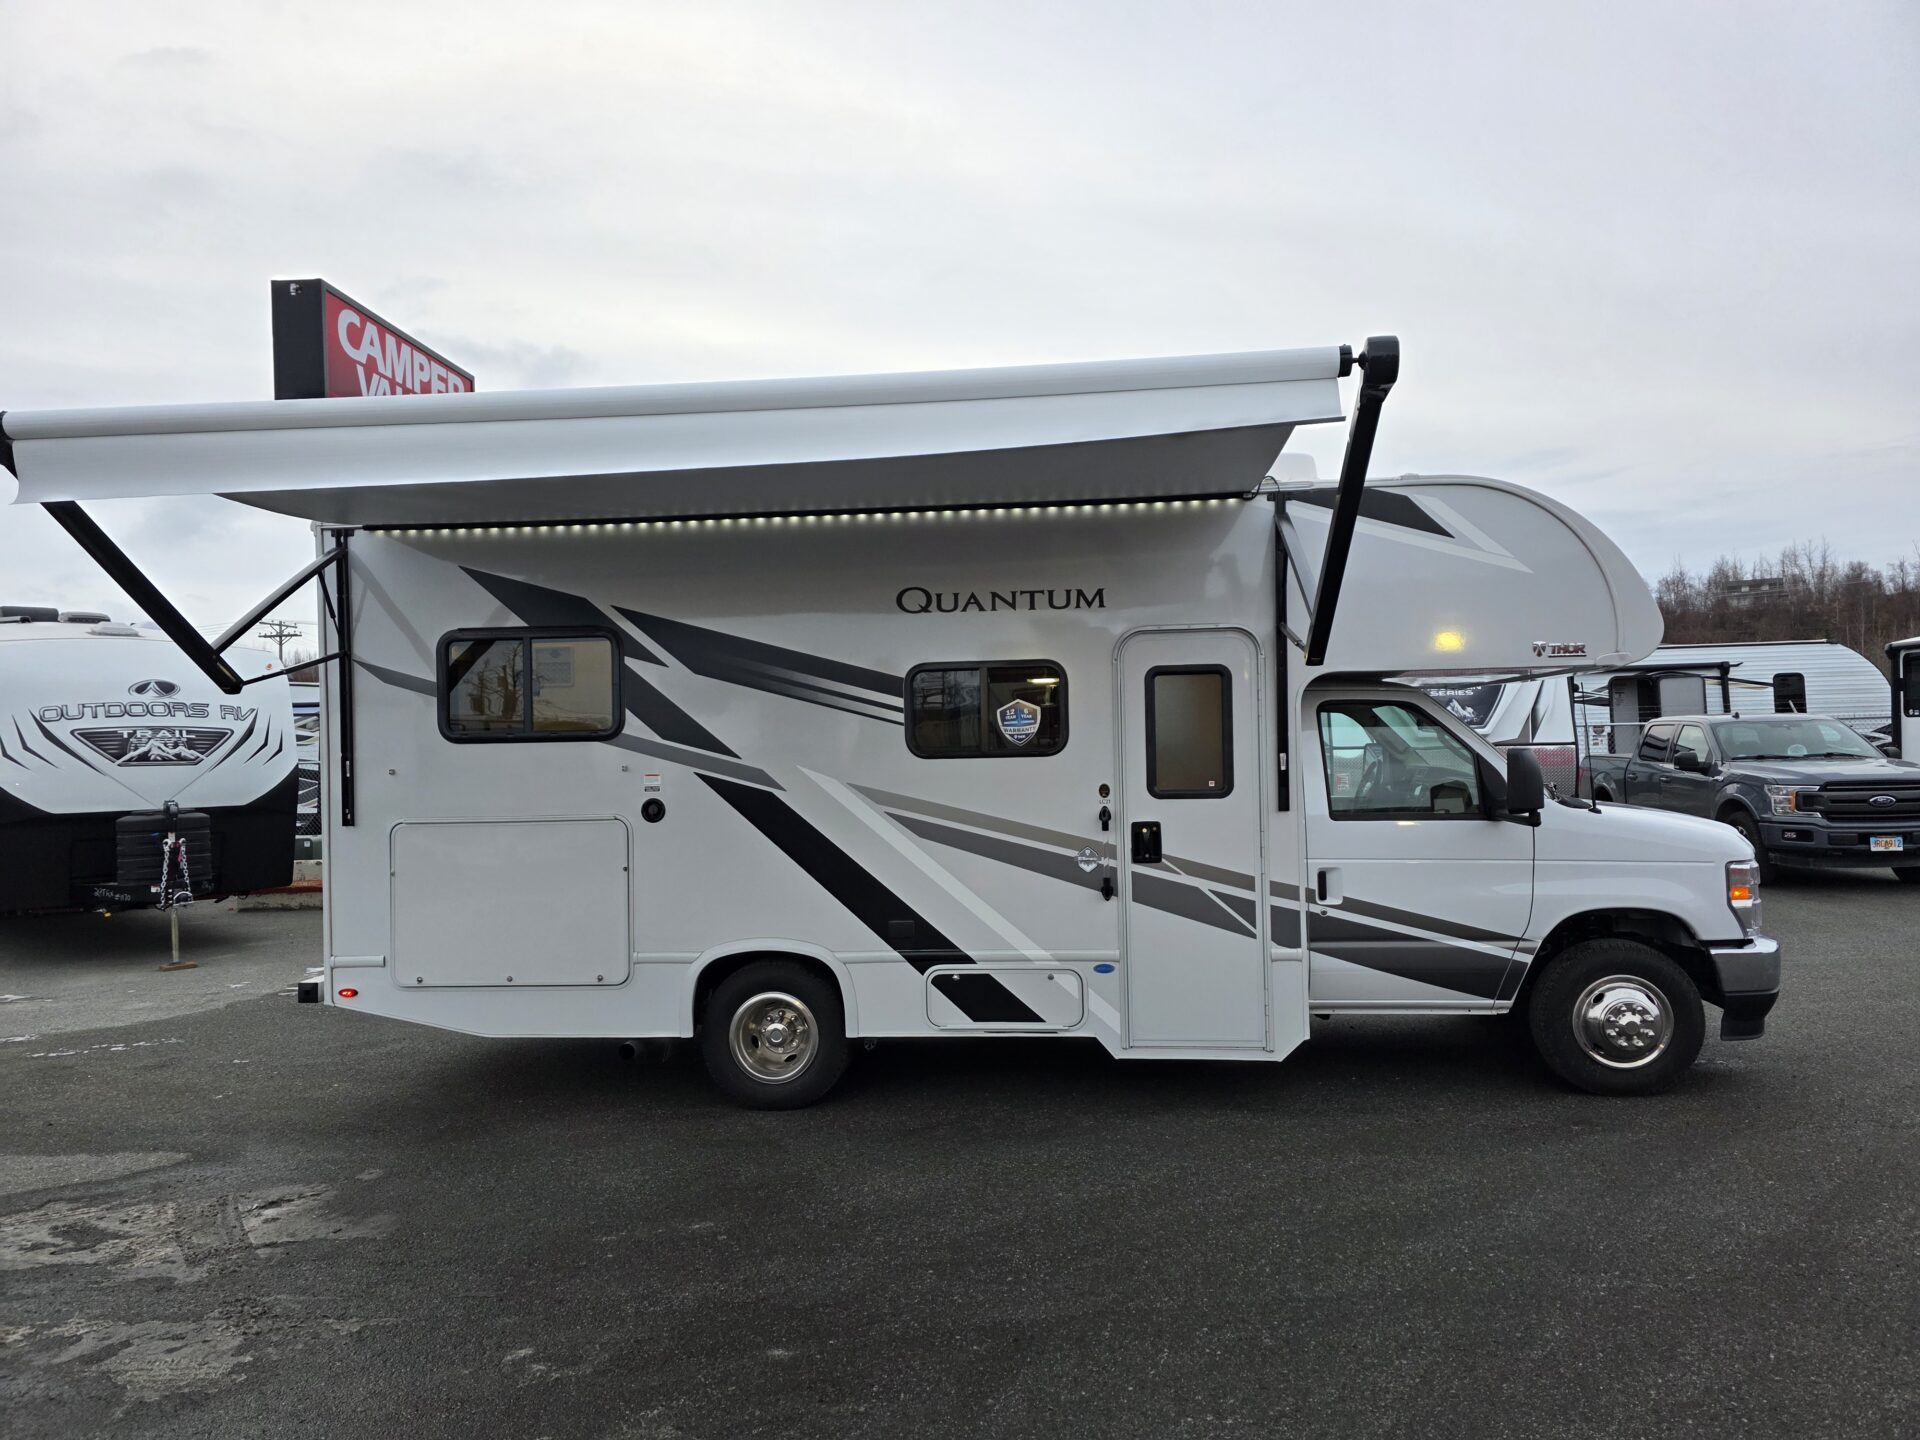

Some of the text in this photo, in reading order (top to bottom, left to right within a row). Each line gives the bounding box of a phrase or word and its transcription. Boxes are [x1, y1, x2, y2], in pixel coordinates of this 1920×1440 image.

[896, 586, 1106, 614] QUANTUM
[1429, 689, 1474, 697] SERIES
[39, 702, 256, 722] OUTDOORS RV
[117, 729, 196, 739] TRAIL
